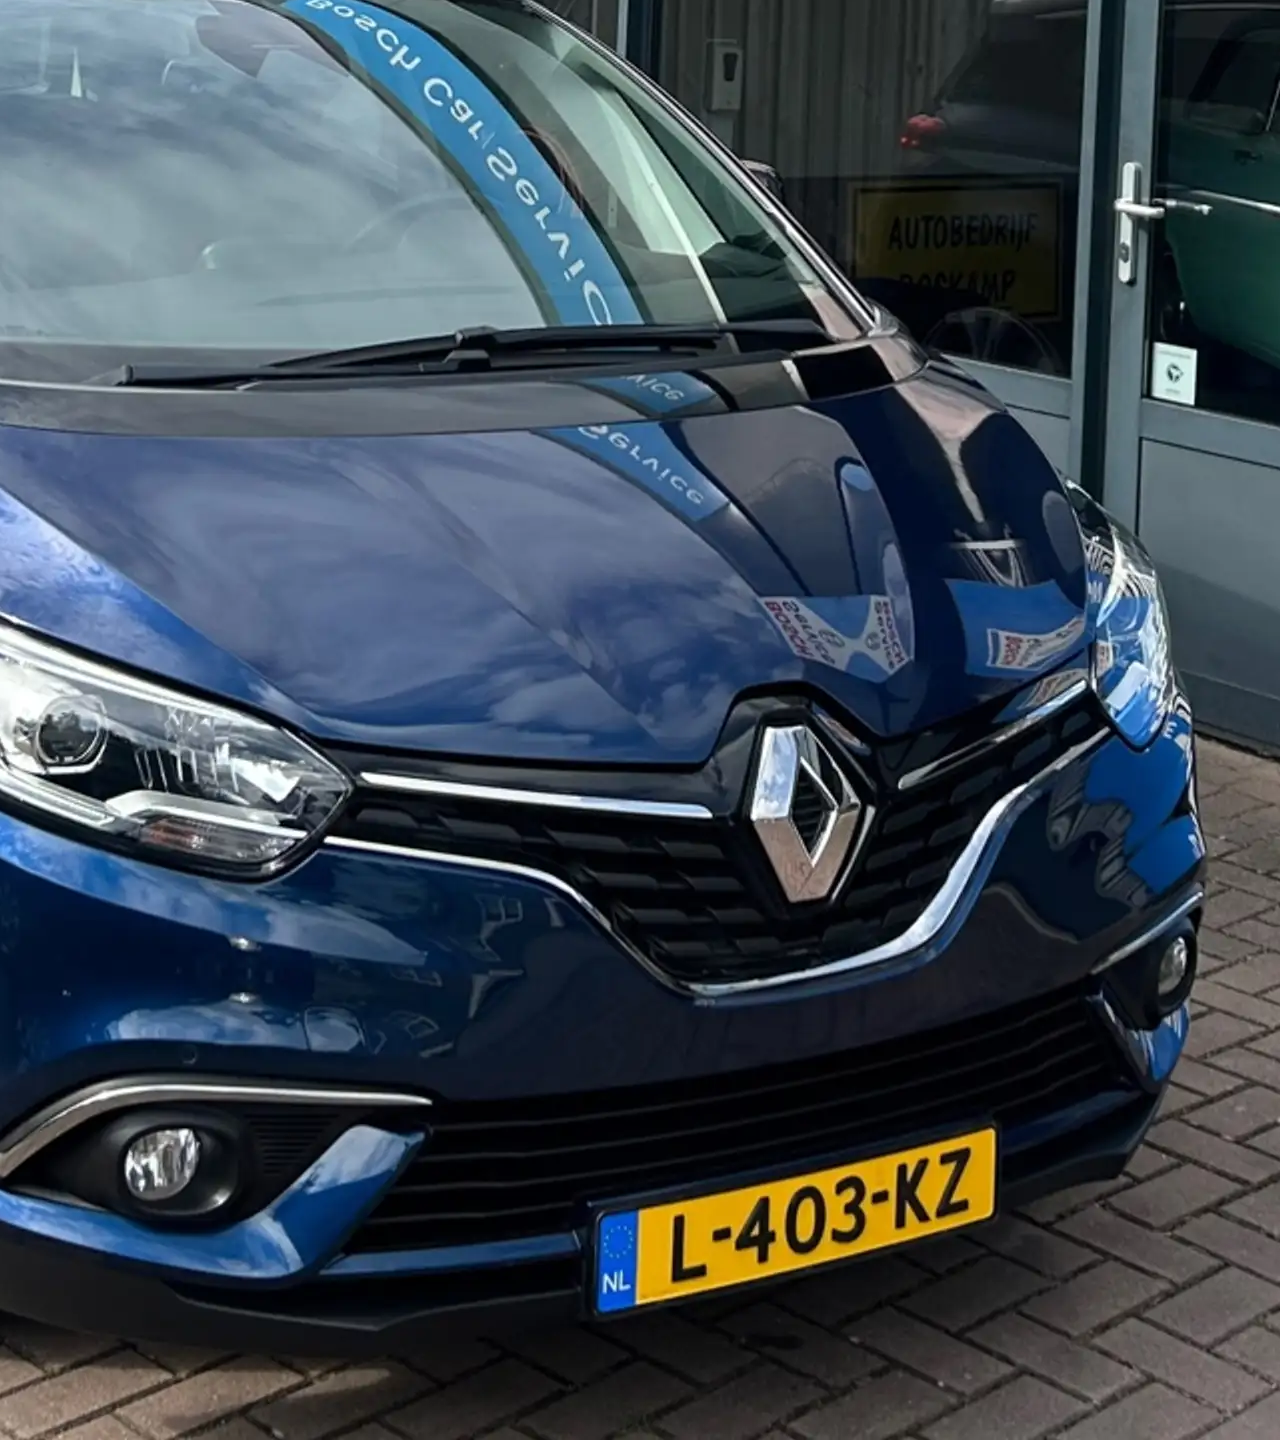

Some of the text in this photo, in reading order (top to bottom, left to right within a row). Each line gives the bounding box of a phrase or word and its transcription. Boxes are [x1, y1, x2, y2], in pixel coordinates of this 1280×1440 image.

[886, 213, 1039, 252] AUTOBEDRIJF
[671, 1147, 972, 1284] L-403-KZ
[601, 1270, 632, 1294] NL
